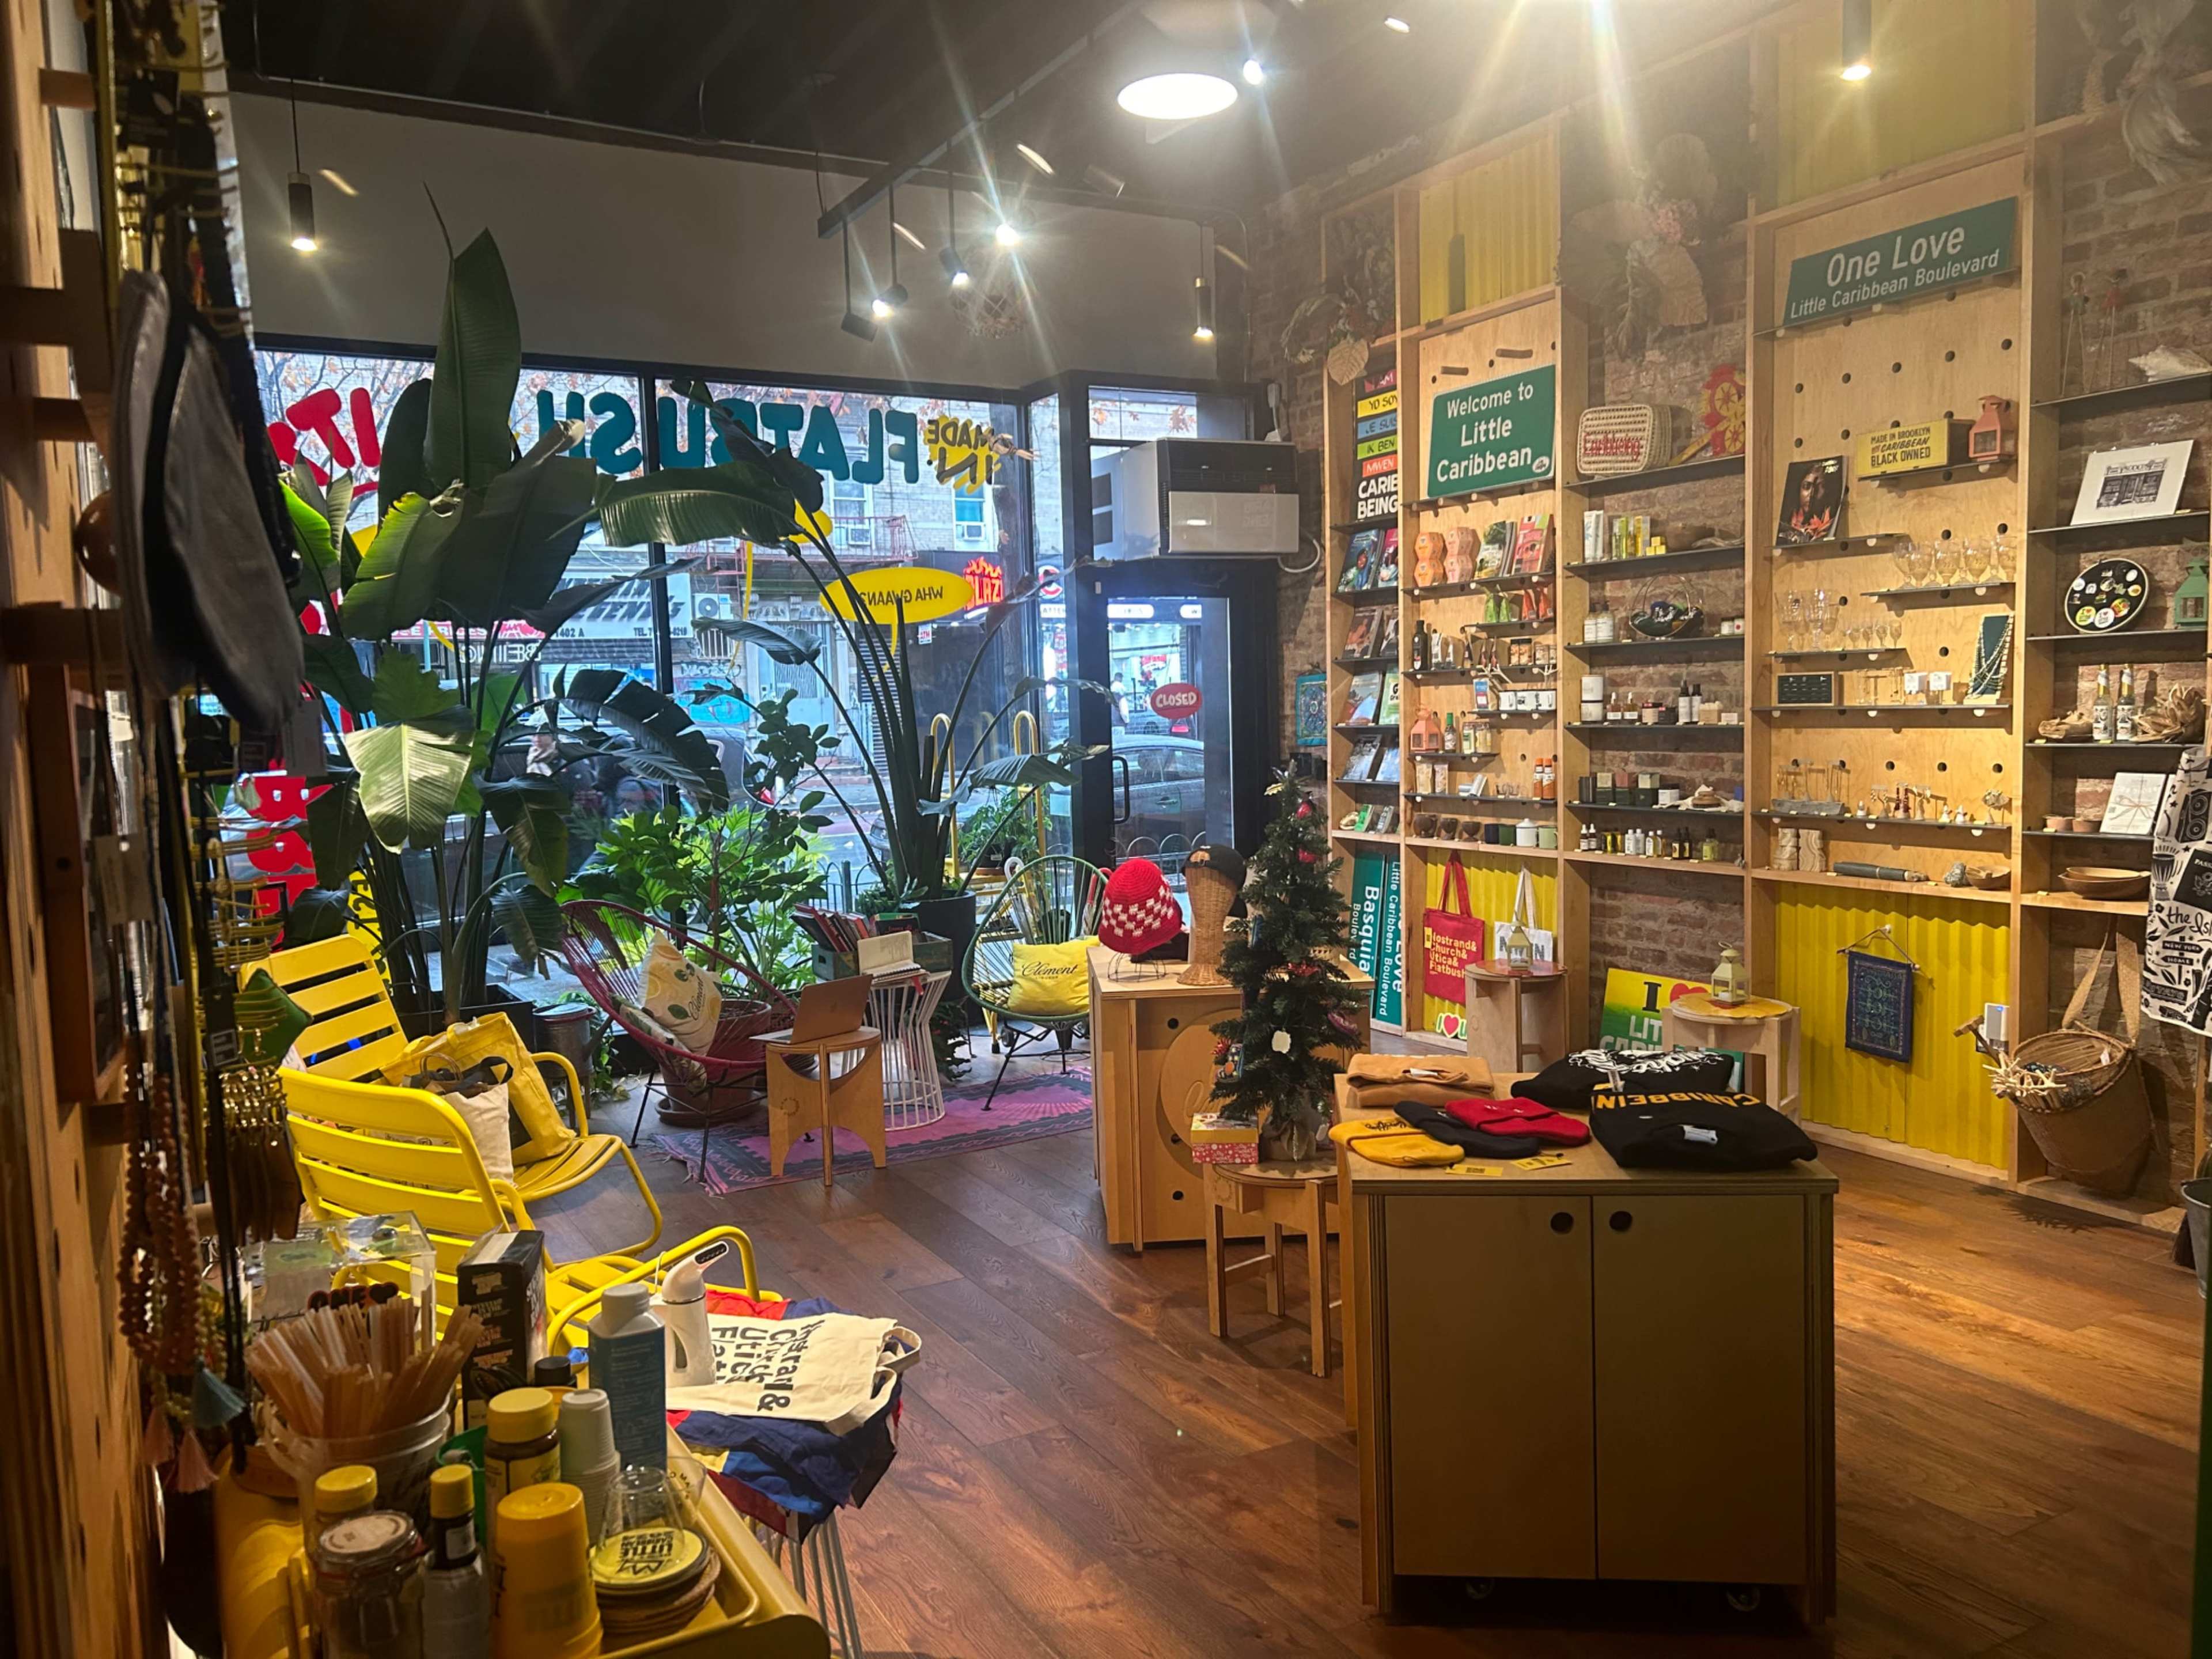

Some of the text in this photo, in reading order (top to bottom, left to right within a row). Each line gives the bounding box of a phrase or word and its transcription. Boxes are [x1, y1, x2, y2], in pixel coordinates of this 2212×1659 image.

[1827, 227, 1965, 287] One Love
[1790, 248, 1999, 319] Little Caribbean Boulevard
[1369, 397, 1381, 411] YO
[1446, 381, 1534, 419] Welcome to
[1378, 438, 1395, 452] BEN
[1460, 416, 1513, 448] Little
[1871, 426, 1931, 445] MADE IN BROOKLYN
[1881, 436, 1930, 453] CARIBBEAN
[1366, 458, 1394, 475] MWEN
[1436, 446, 1533, 483] Caribbean
[1871, 446, 1931, 467] BLACK OWNED
[1357, 494, 1399, 521] BEING
[1155, 691, 1198, 707] CLOSED
[2166, 906, 2190, 925] the
[1349, 903, 1361, 960] Boulevrd
[1358, 885, 1380, 977] Basquia
[1379, 861, 1400, 1016] Little Caribbean Boulevard
[1642, 981, 1662, 1013] I
